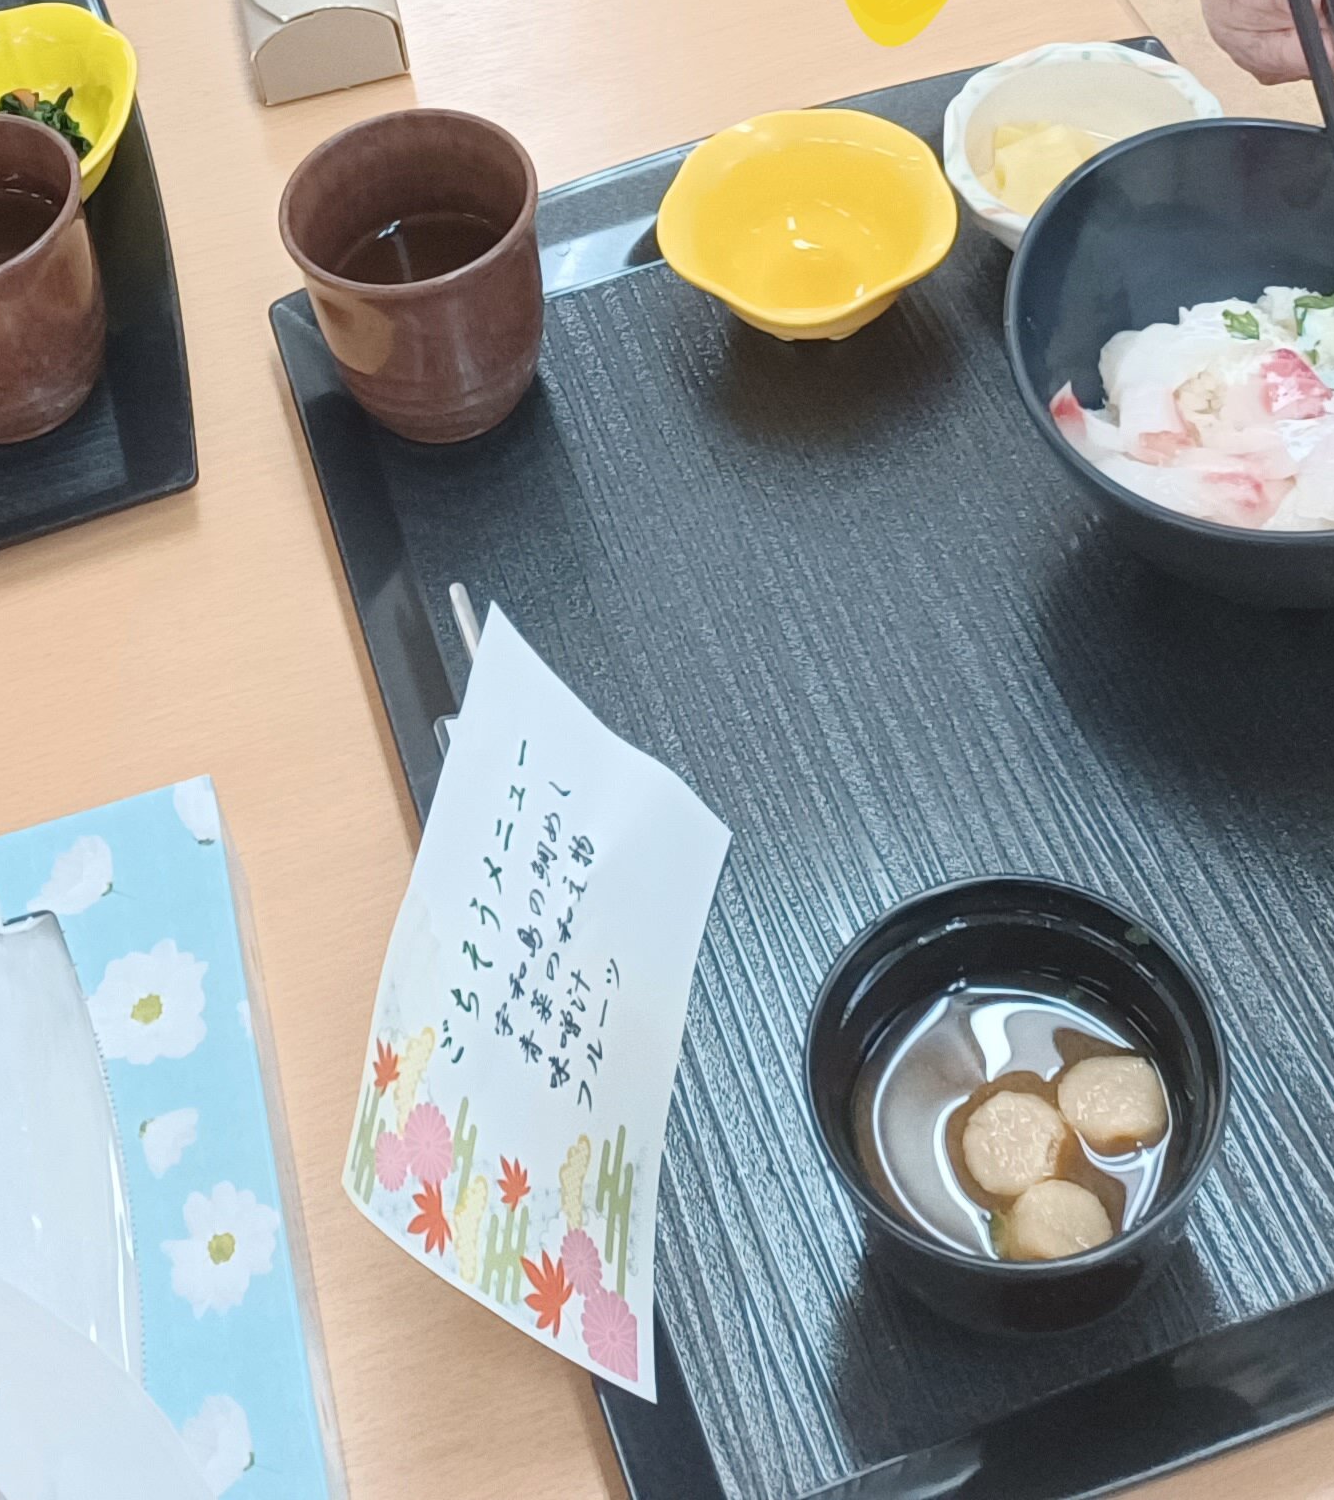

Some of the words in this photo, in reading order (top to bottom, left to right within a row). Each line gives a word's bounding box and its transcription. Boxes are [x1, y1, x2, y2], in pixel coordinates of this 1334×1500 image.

[441, 740, 526, 1065] ごちそうメニュー
[495, 781, 571, 1036] 宇和島の鯛めし
[519, 835, 595, 1064] 青菜の和え物
[550, 969, 590, 1089] 味噌汁
[578, 958, 620, 1112] フルーツ
